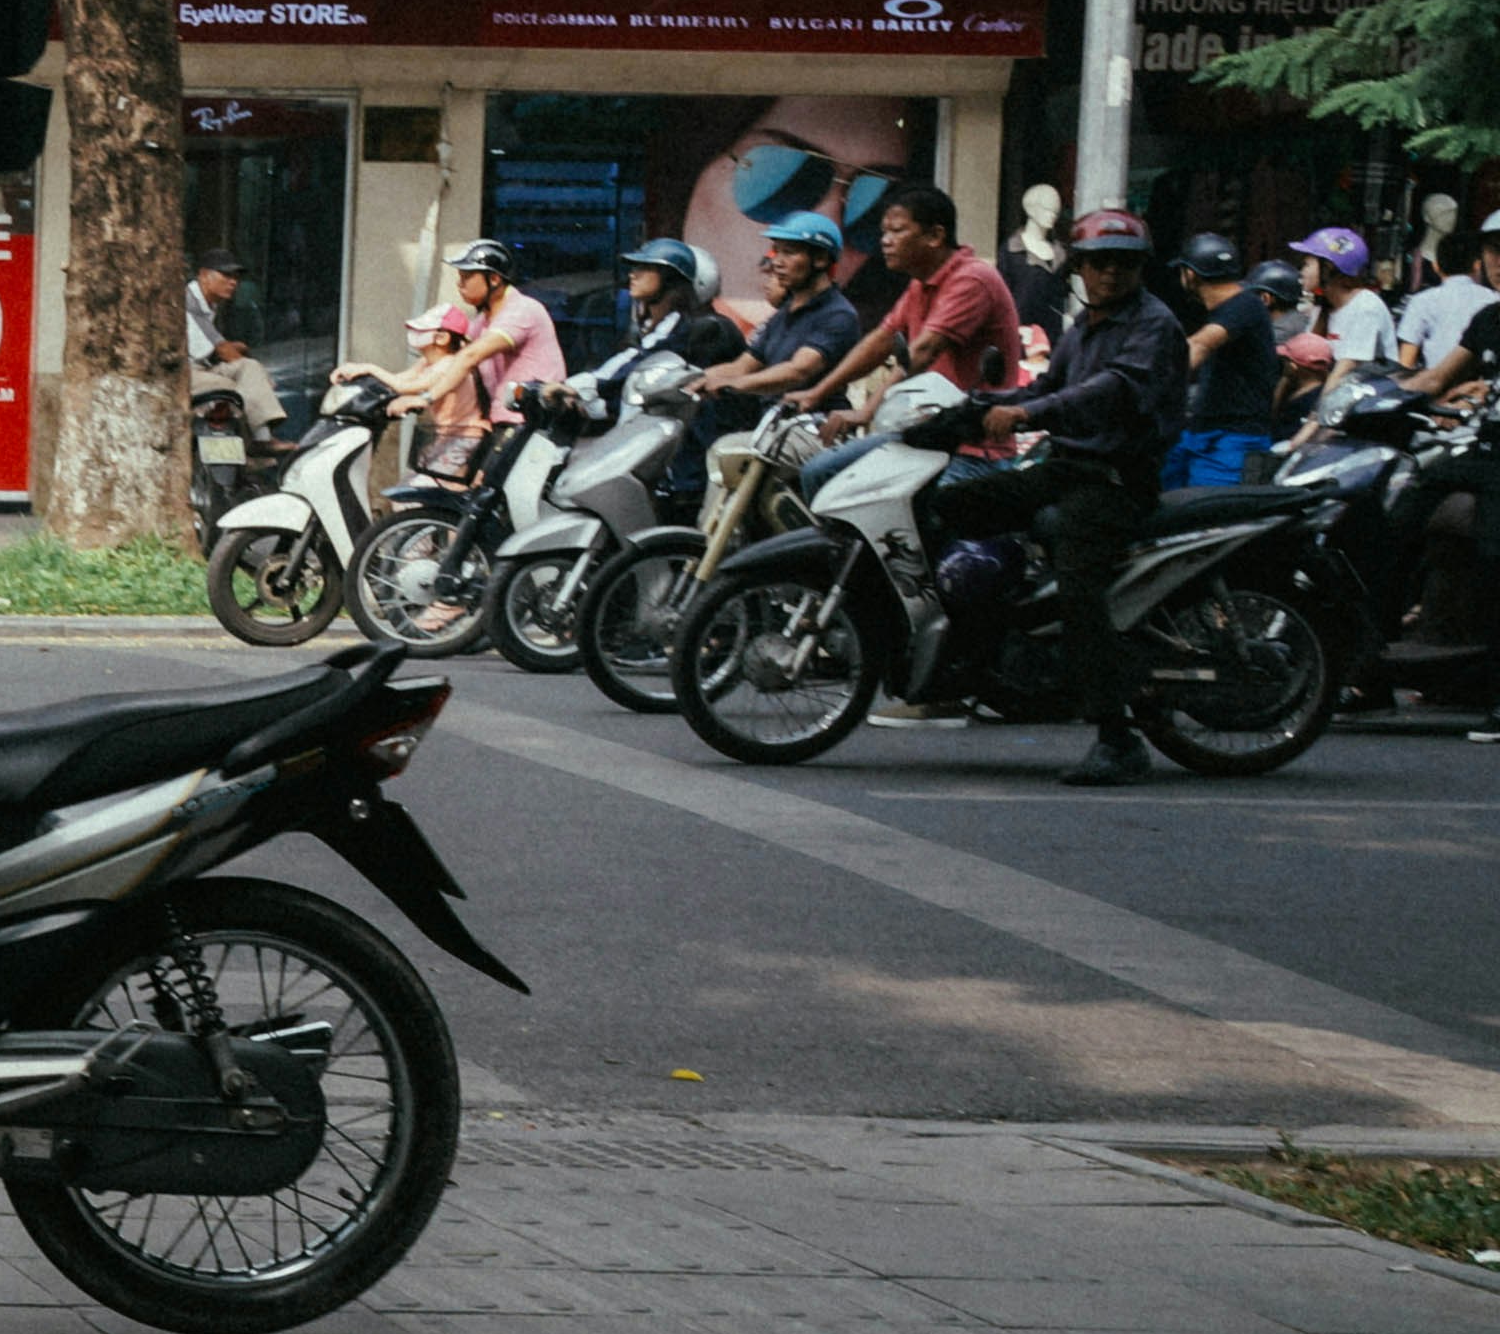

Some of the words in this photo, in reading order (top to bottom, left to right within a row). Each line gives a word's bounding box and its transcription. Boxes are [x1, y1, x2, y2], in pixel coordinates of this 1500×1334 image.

[179, 3, 266, 27] EyeWear
[768, 17, 864, 31] BVLGARI
[871, 19, 953, 33] OAKLEY
